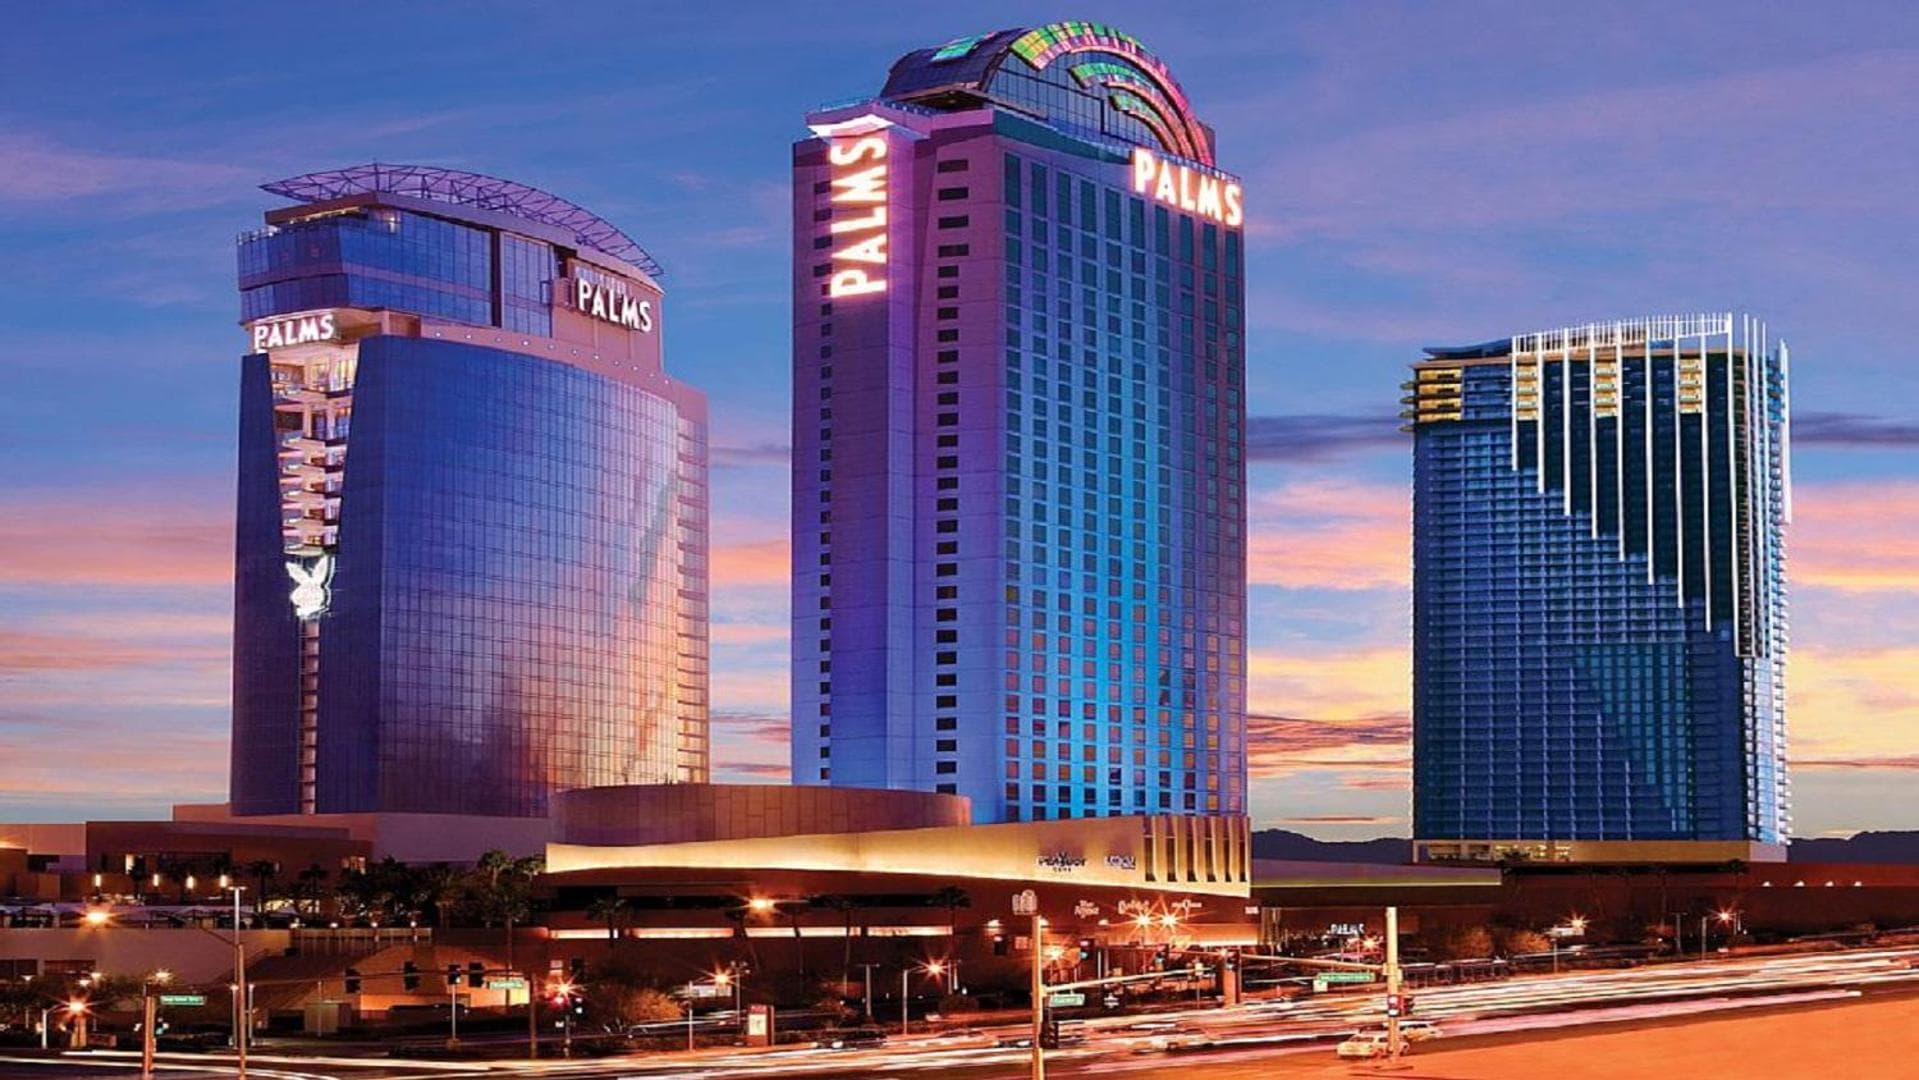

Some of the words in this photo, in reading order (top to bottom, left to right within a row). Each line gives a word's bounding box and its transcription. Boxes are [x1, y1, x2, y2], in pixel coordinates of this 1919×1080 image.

[830, 137, 887, 298] PALMS
[1134, 147, 1241, 226] PALMS
[254, 313, 334, 350] PALMS
[579, 277, 652, 332] PALMS
